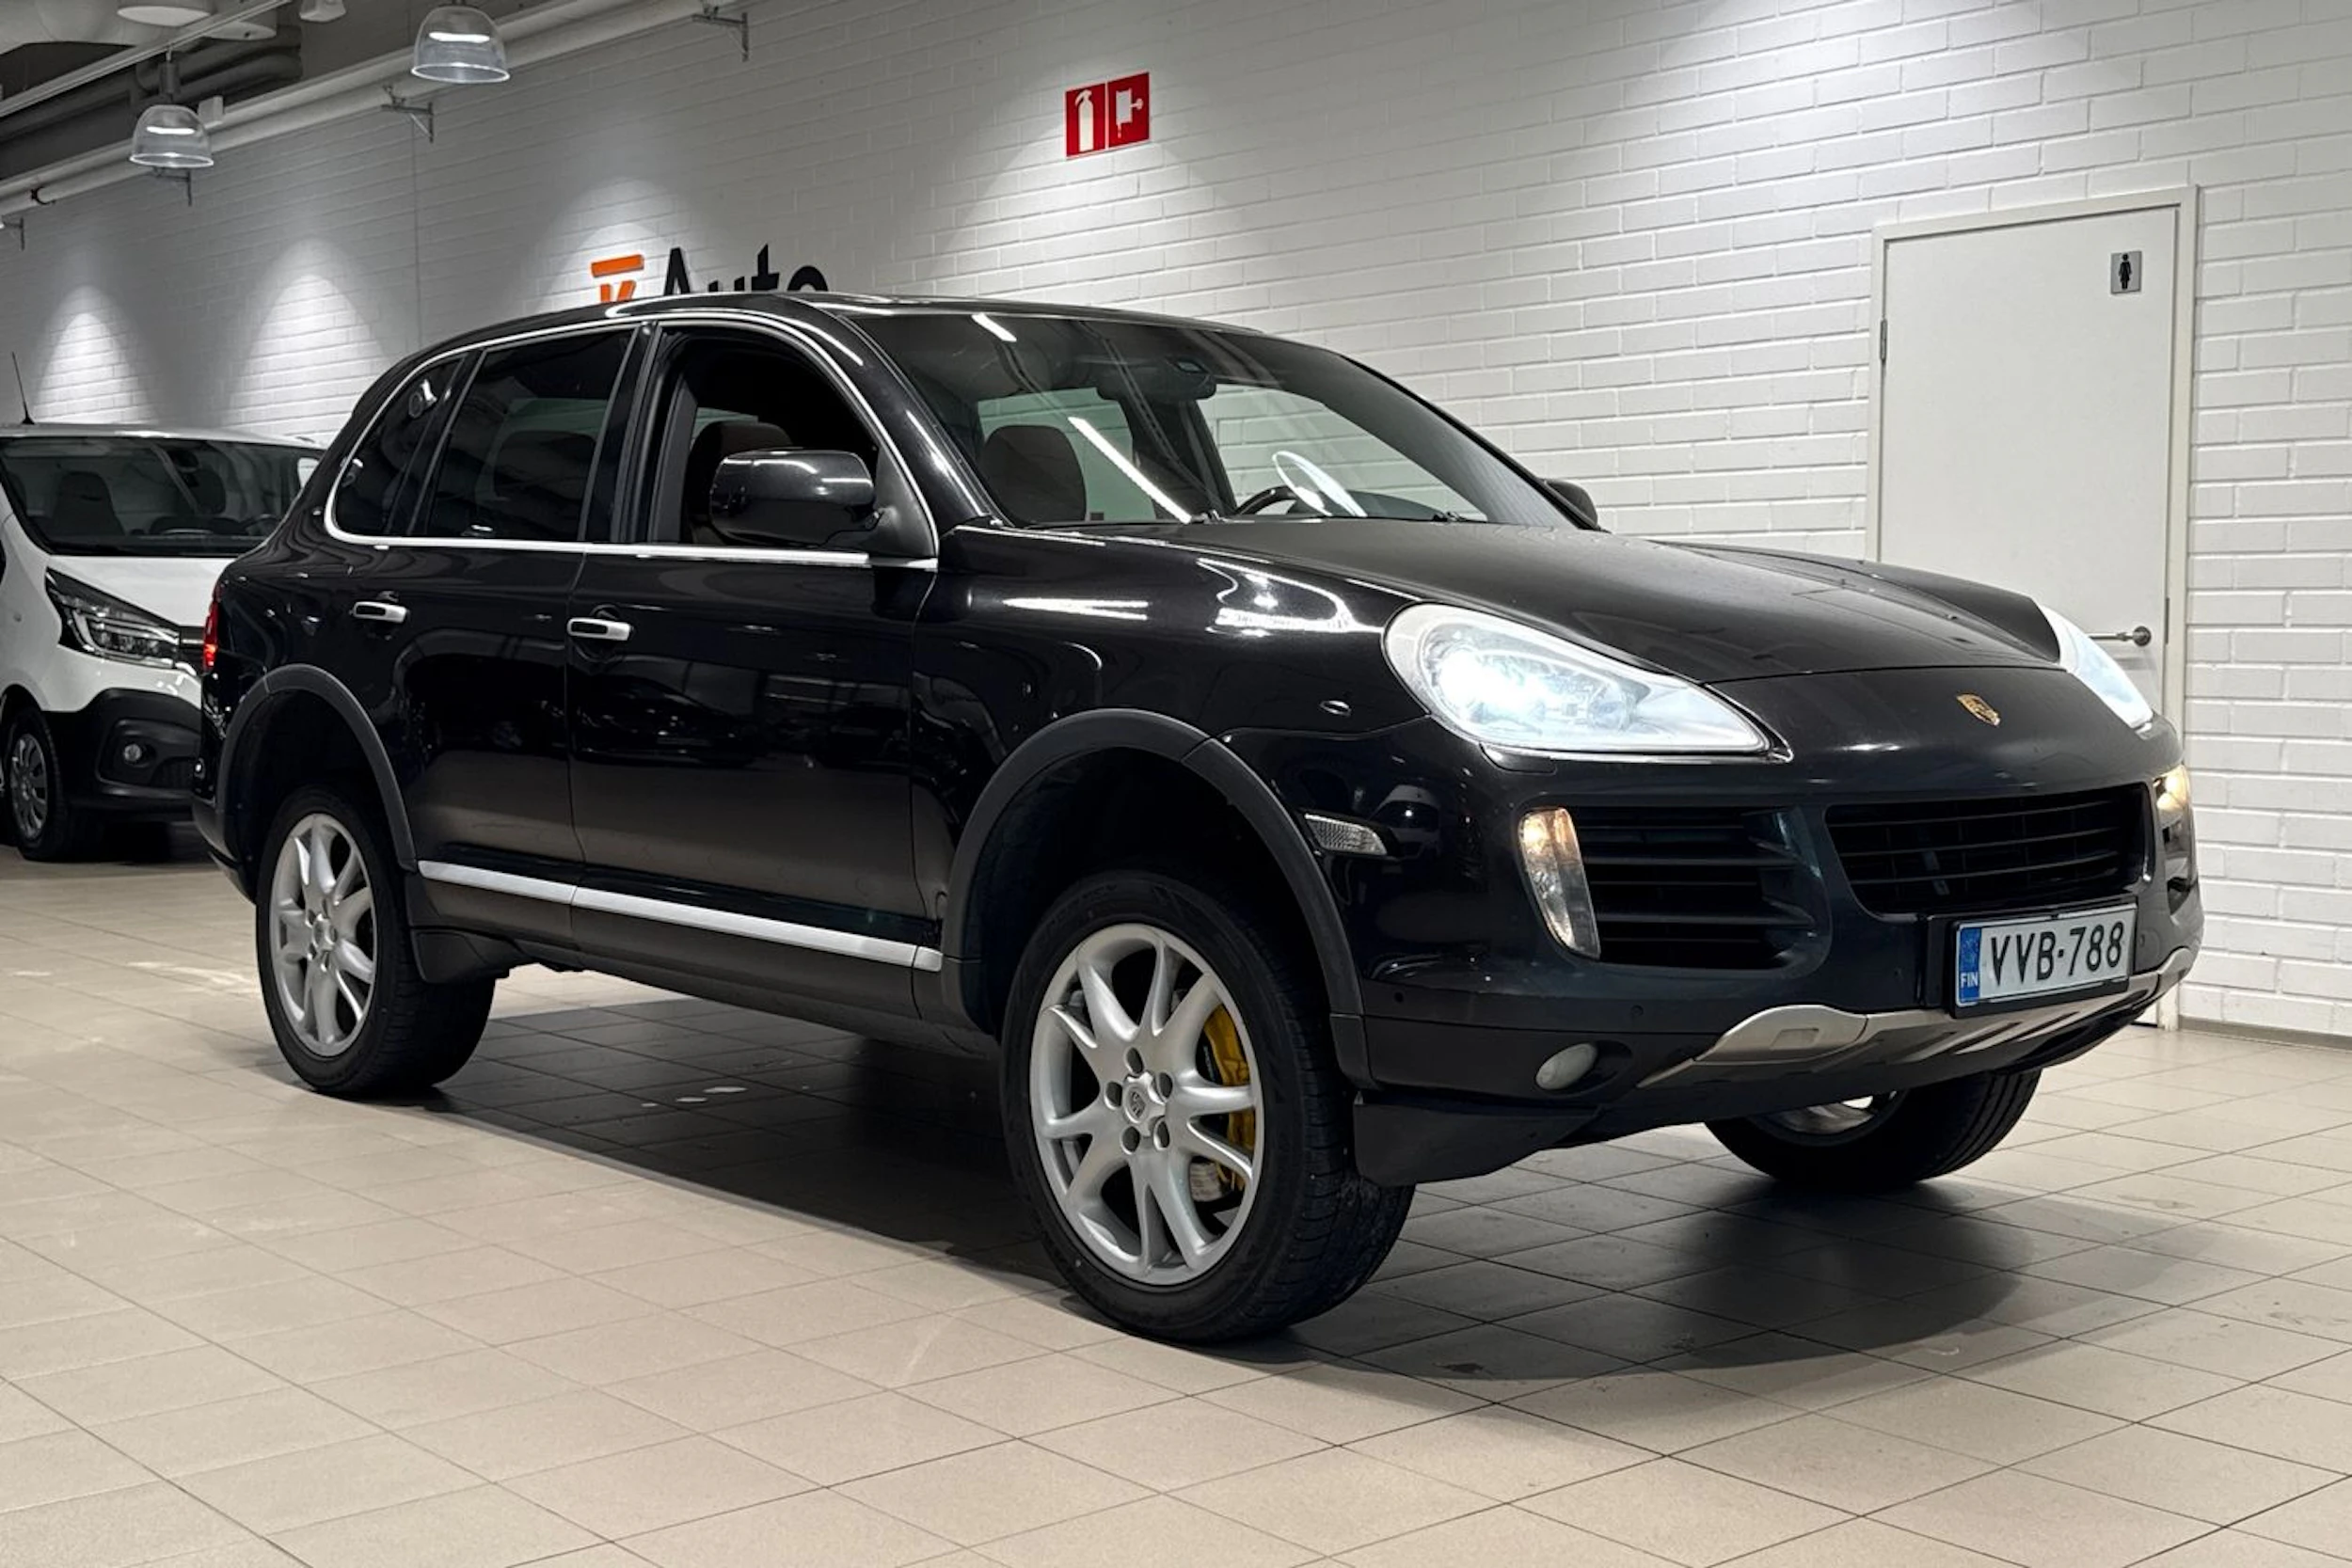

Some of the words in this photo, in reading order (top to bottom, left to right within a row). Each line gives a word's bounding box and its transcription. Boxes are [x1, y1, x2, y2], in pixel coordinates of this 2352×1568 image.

[663, 244, 829, 295] Ato
[1991, 921, 2124, 986] VVB-788
[1960, 971, 1979, 989] FIN
